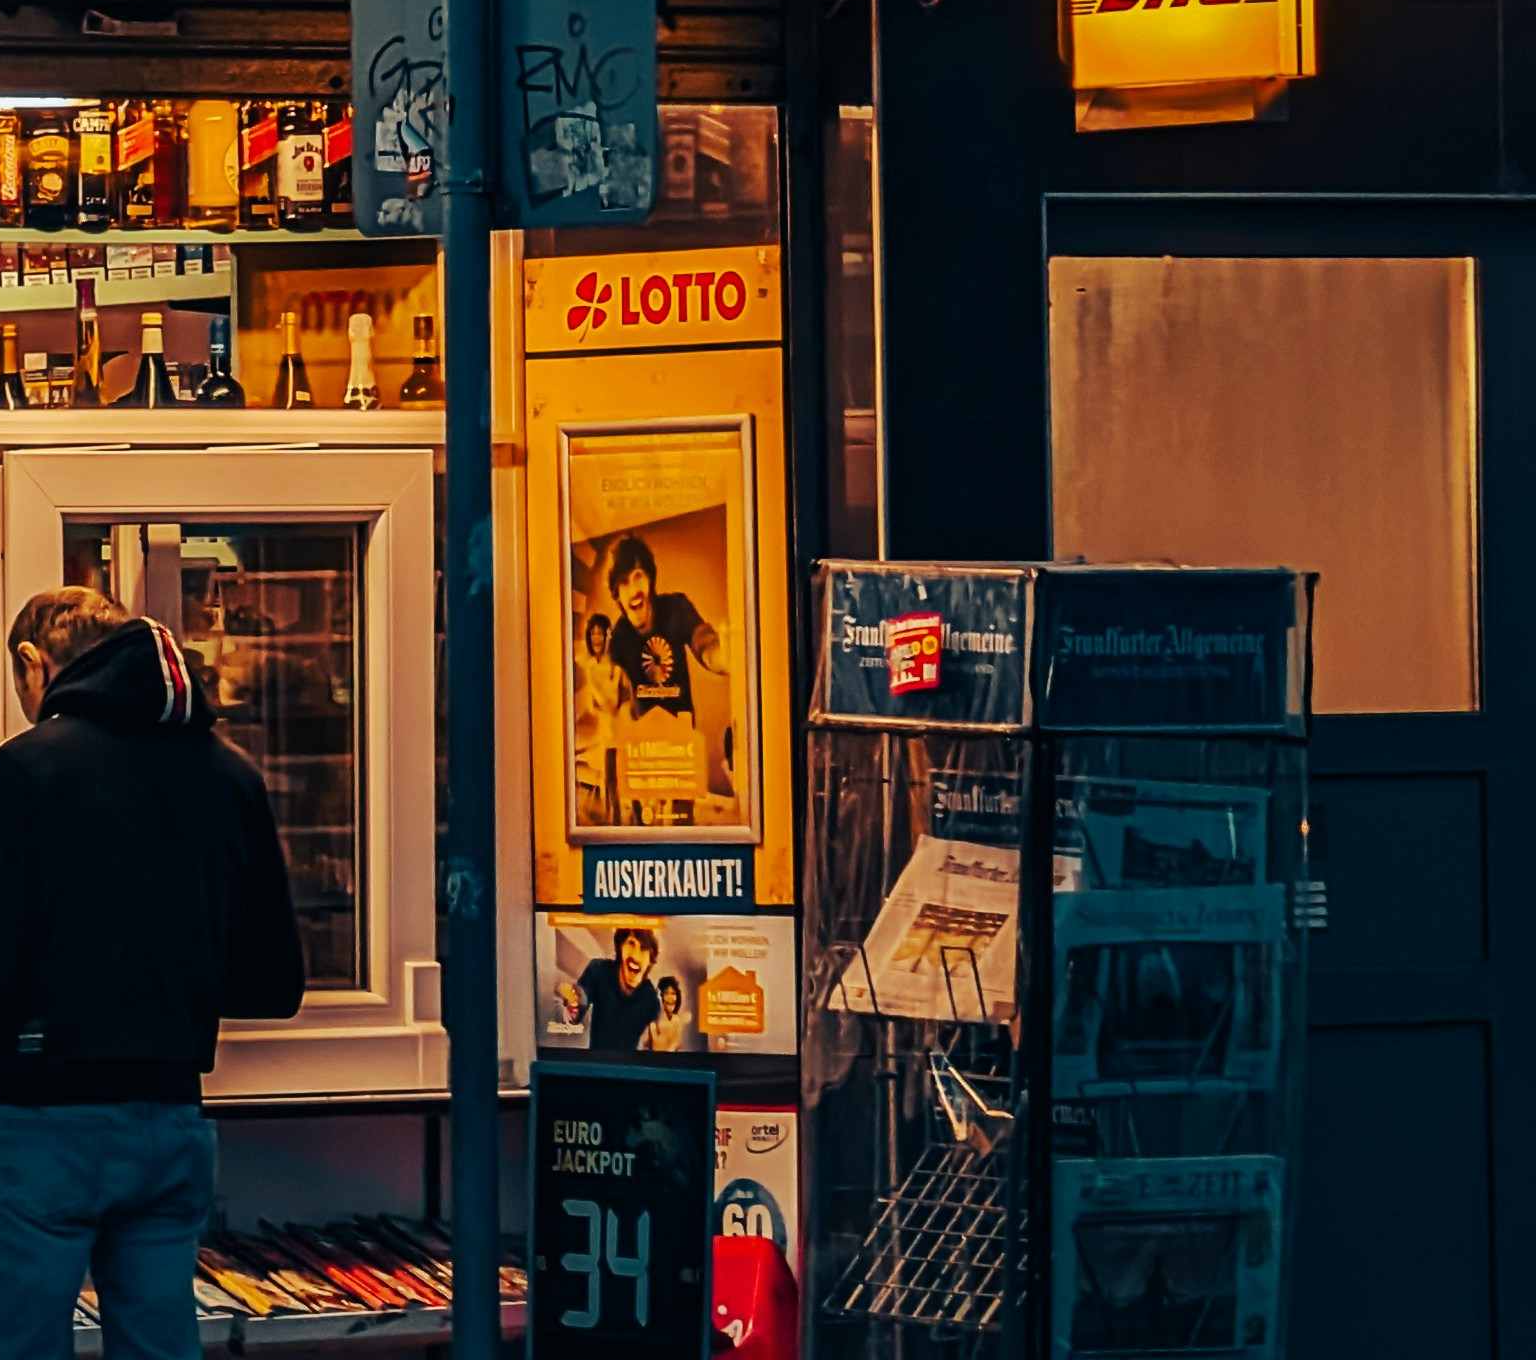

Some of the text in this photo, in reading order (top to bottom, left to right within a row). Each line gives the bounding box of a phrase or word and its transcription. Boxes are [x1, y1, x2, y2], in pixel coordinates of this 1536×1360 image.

[621, 270, 746, 325] LOTTO
[595, 859, 743, 898] AUSVERKAUFT!
[554, 1120, 602, 1145] EURO
[751, 1124, 780, 1137] ortel
[552, 1151, 636, 1177] JACKPOT
[561, 1199, 650, 1328] 34
